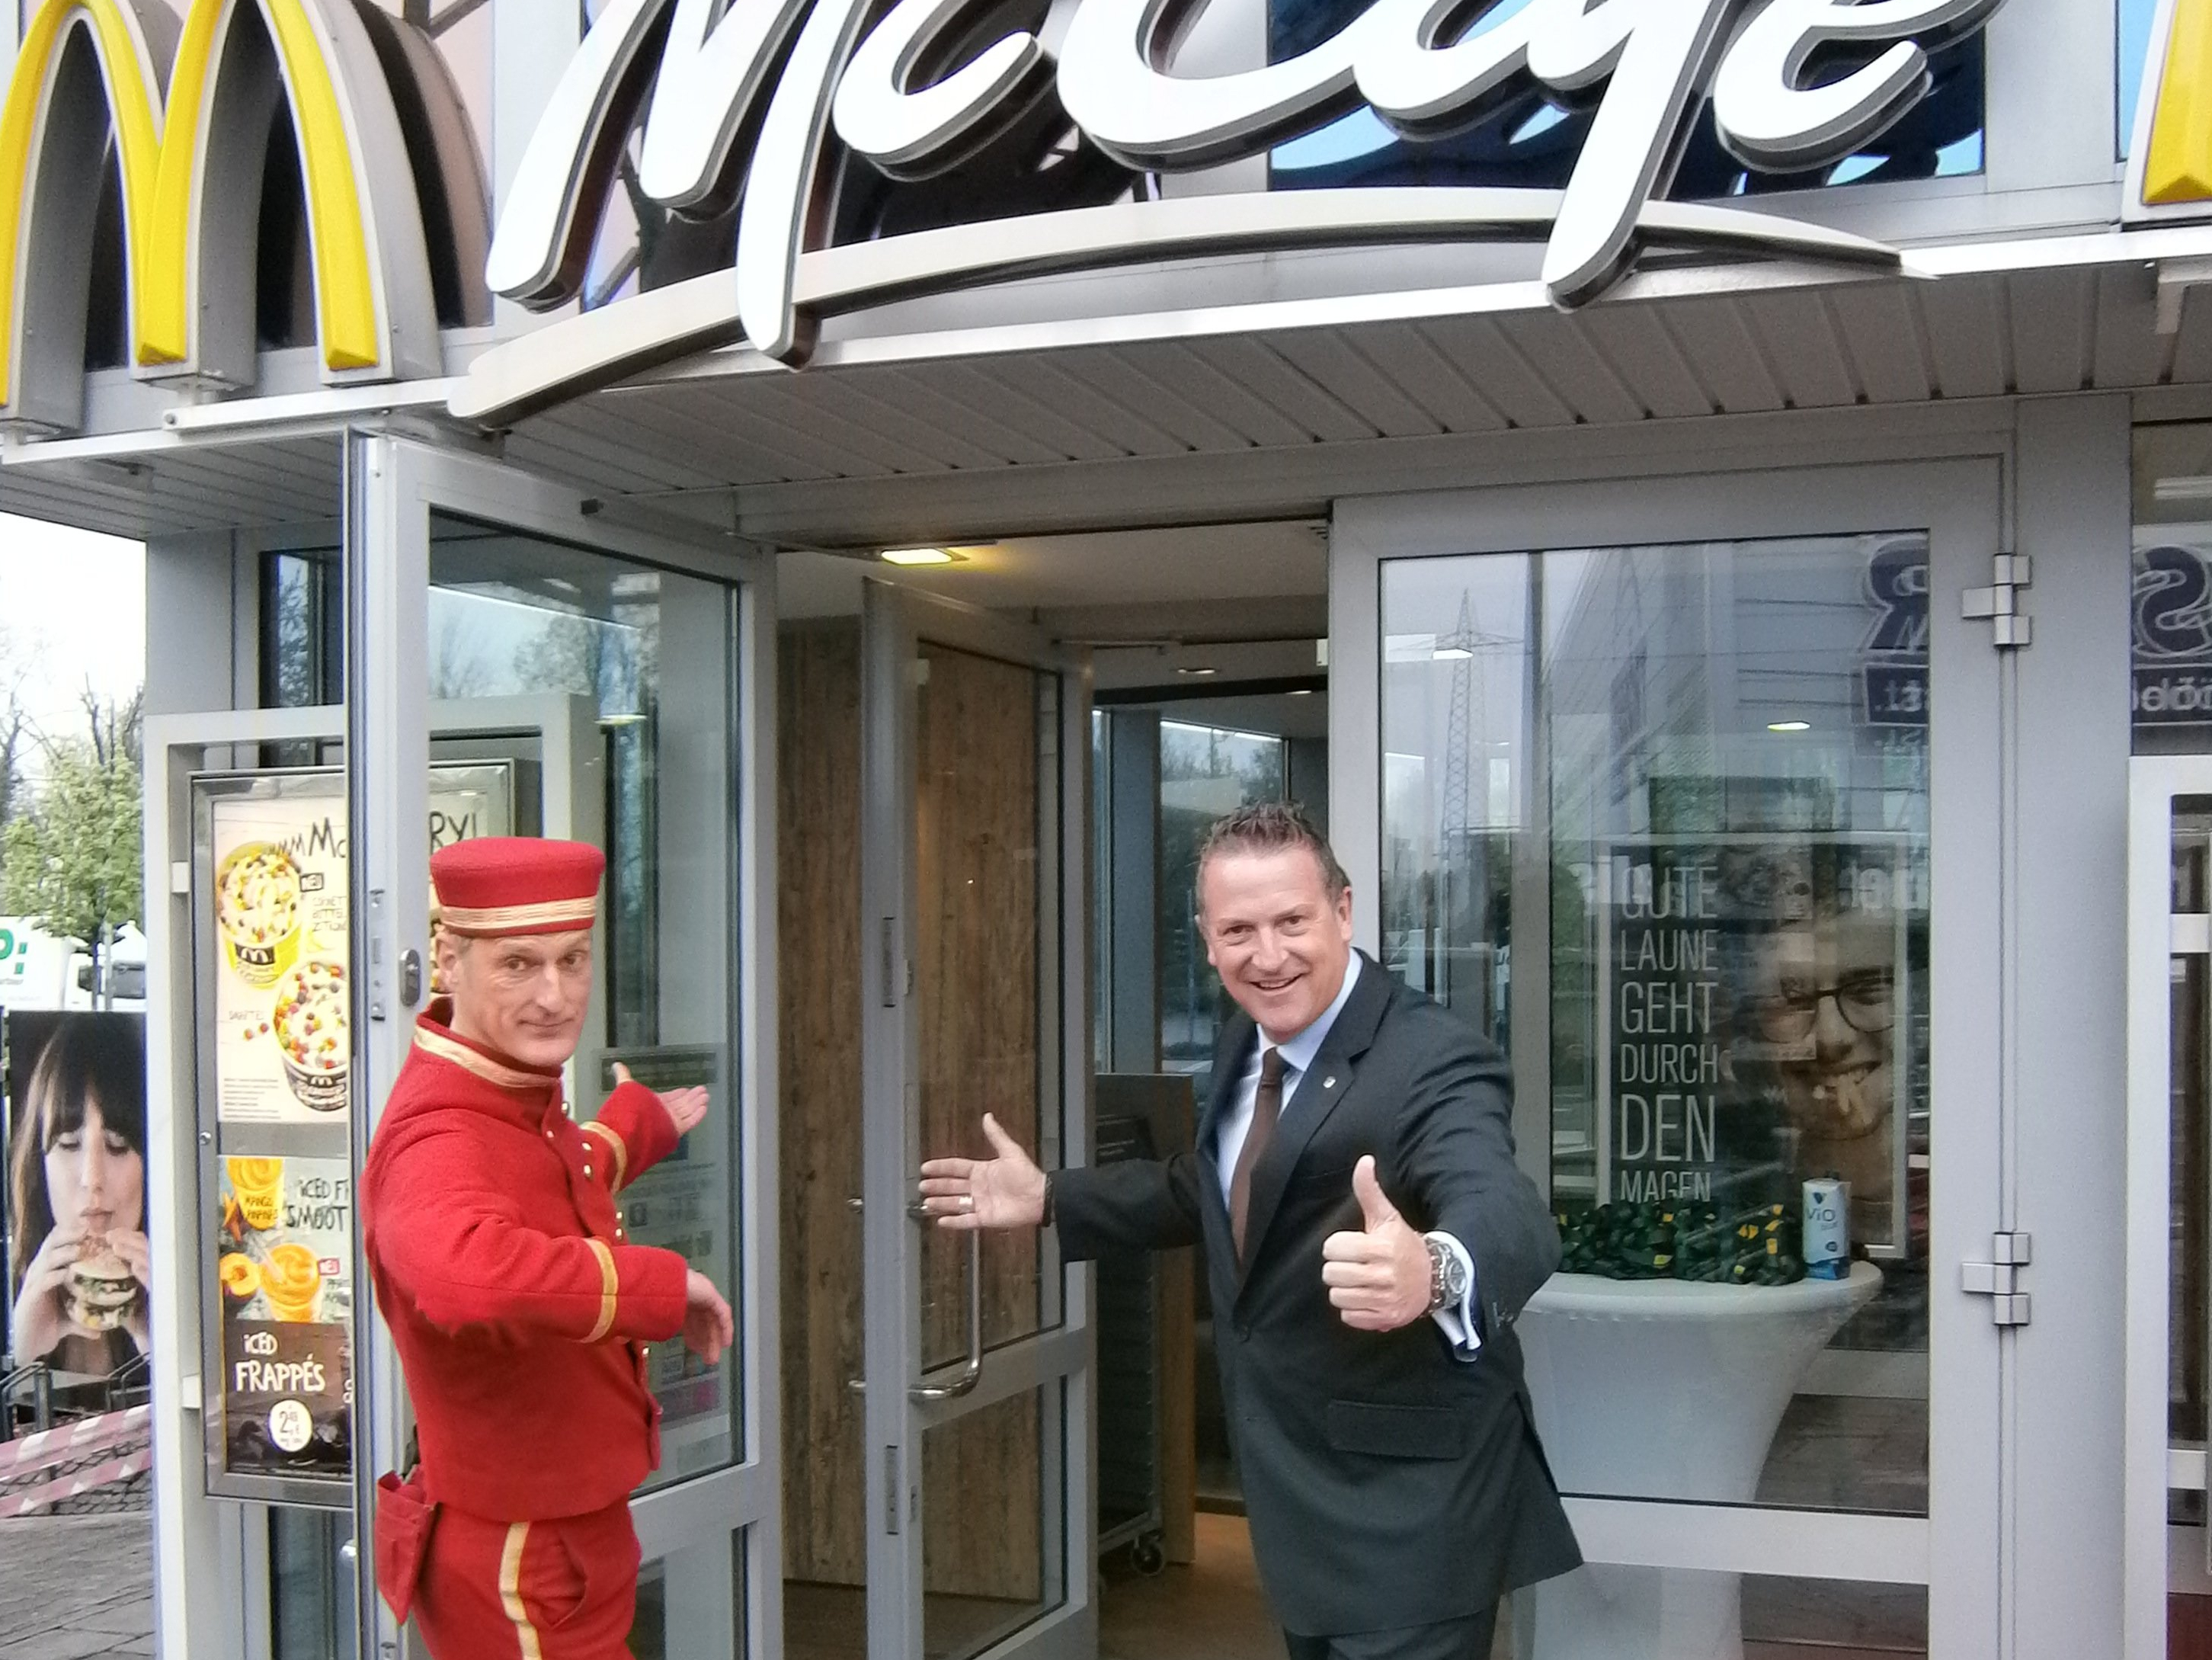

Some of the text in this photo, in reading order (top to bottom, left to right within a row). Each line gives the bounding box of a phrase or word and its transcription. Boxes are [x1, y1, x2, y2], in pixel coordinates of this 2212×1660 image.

[1621, 865, 1718, 920] GUTE
[1620, 929, 1718, 972] LAUNE
[1620, 981, 1719, 1034] GEHT
[1620, 1043, 1718, 1084] DURCH
[1620, 1094, 1716, 1163] DEN
[1620, 1171, 1711, 1203] MAGEN
[235, 1353, 325, 1392] FRAPPÉS
